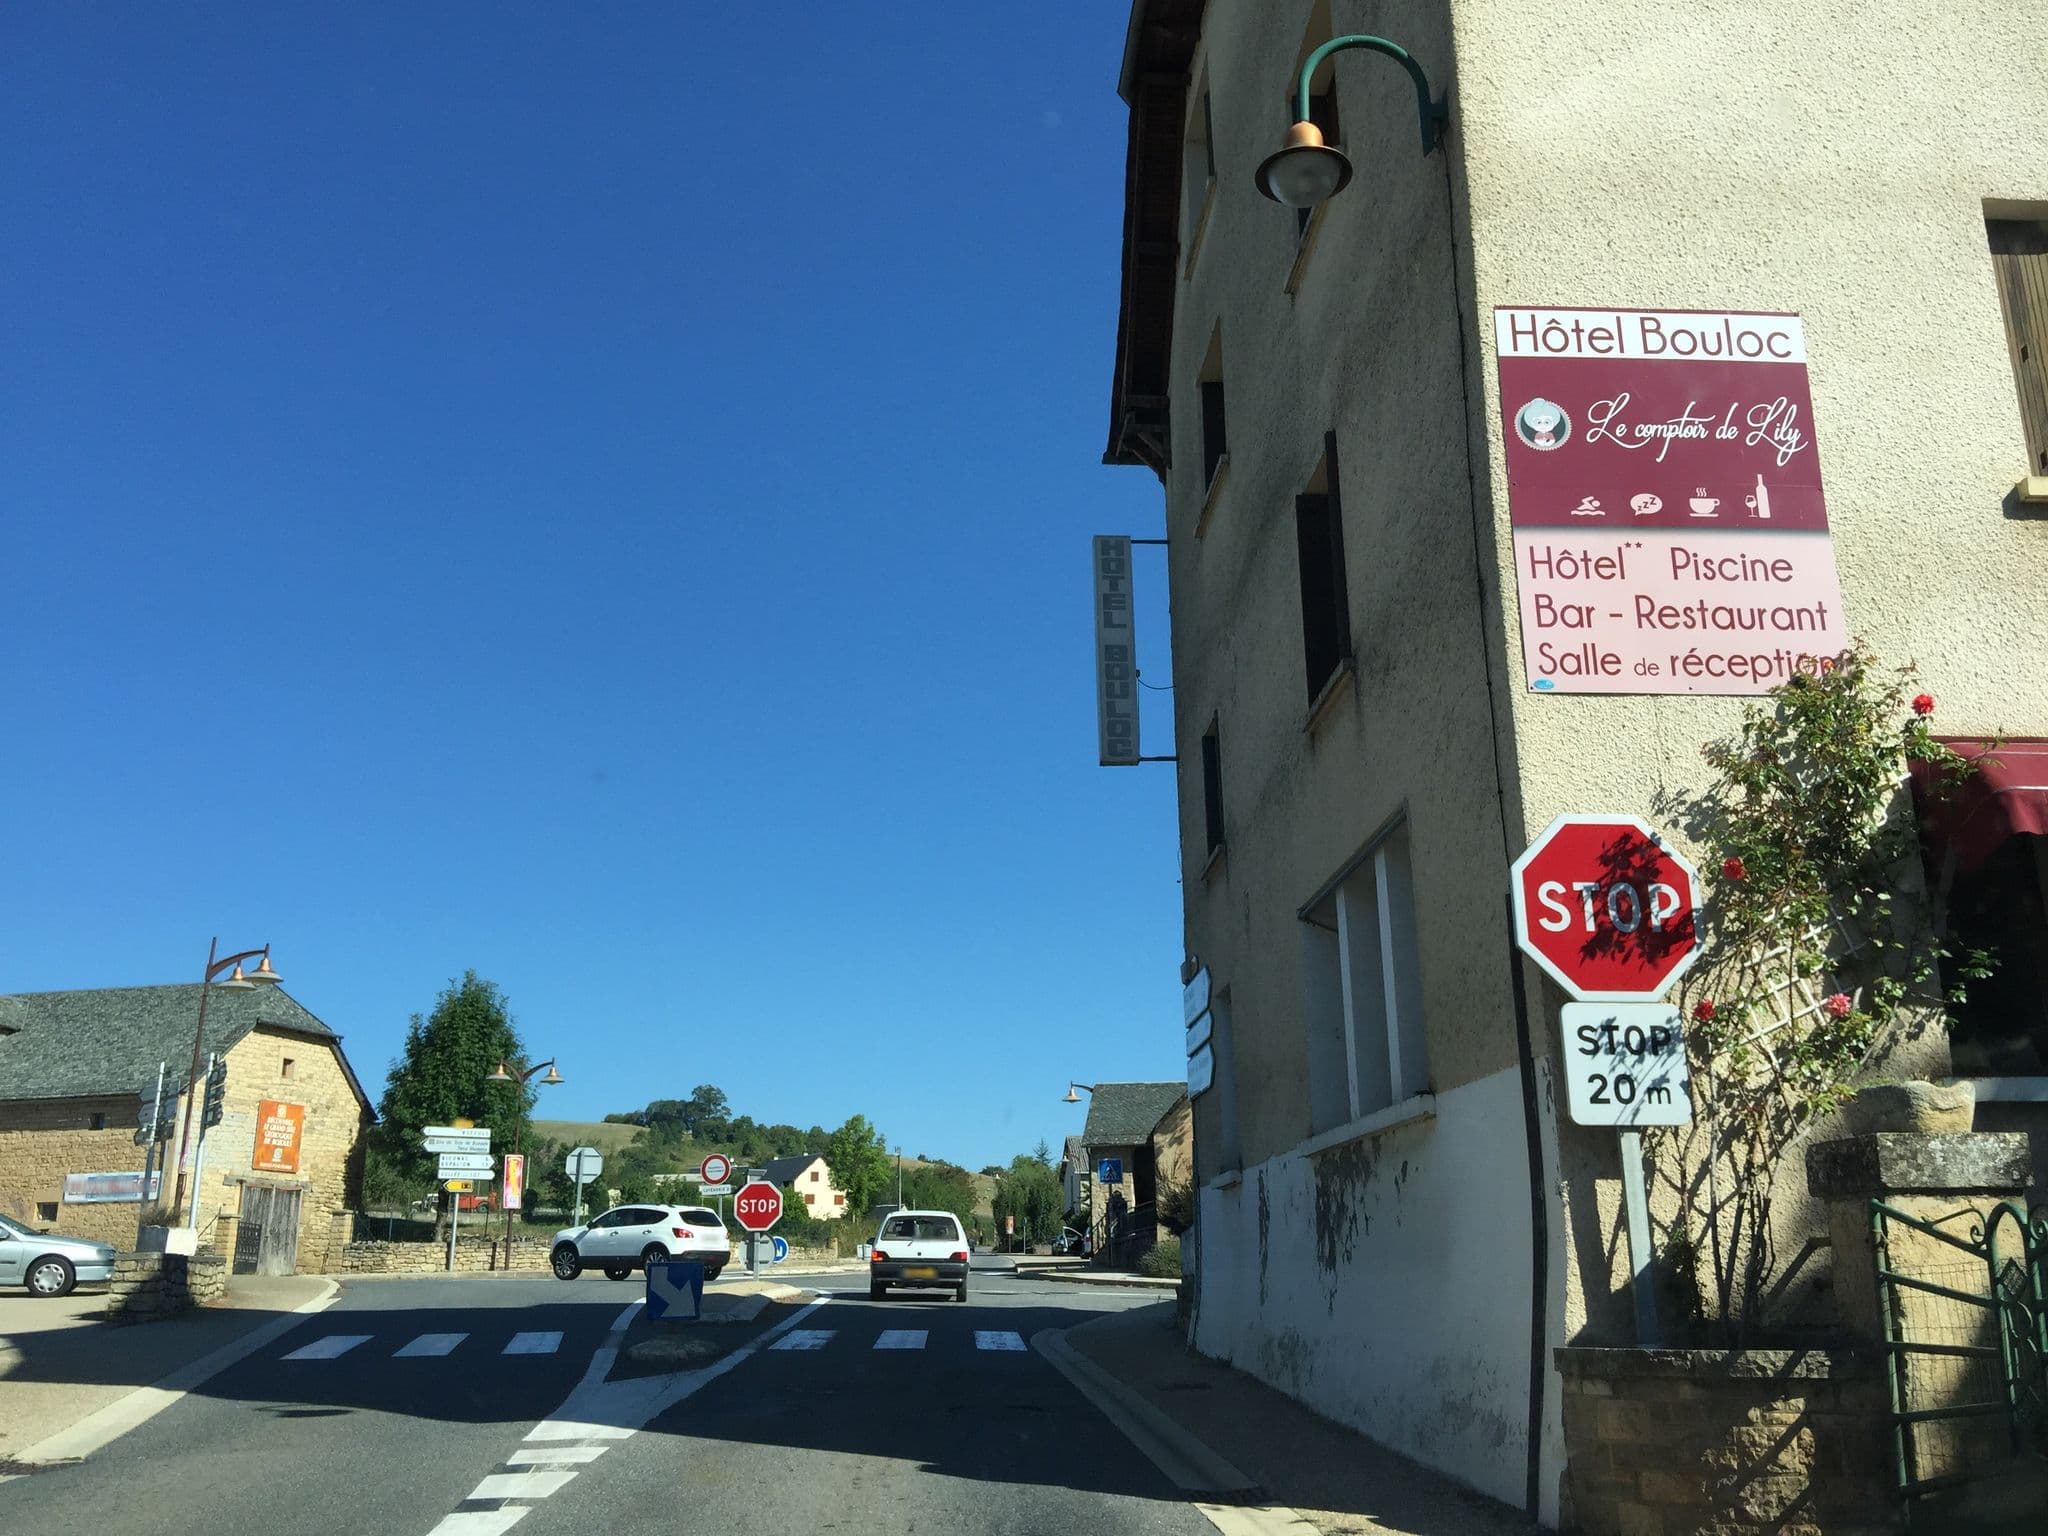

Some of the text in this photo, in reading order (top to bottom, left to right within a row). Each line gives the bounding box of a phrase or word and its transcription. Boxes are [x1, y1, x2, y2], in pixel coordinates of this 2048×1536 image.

[1510, 313, 1792, 359] Hôtel Bouloc
[1586, 392, 1808, 467] Le comptoir de Lily
[1671, 547, 1793, 583] Piscine
[1101, 539, 1127, 629] HOTEL
[1534, 594, 1596, 629] Bar
[1634, 594, 1828, 631] Restaurant
[1538, 642, 1622, 677] Salle
[1634, 657, 1660, 677] de
[1105, 645, 1132, 757] BOULOC
[1537, 880, 1681, 934] STOP
[1577, 1024, 1672, 1057] STOP
[1588, 1073, 1672, 1105] 20 m
[739, 1198, 778, 1213] STOP
